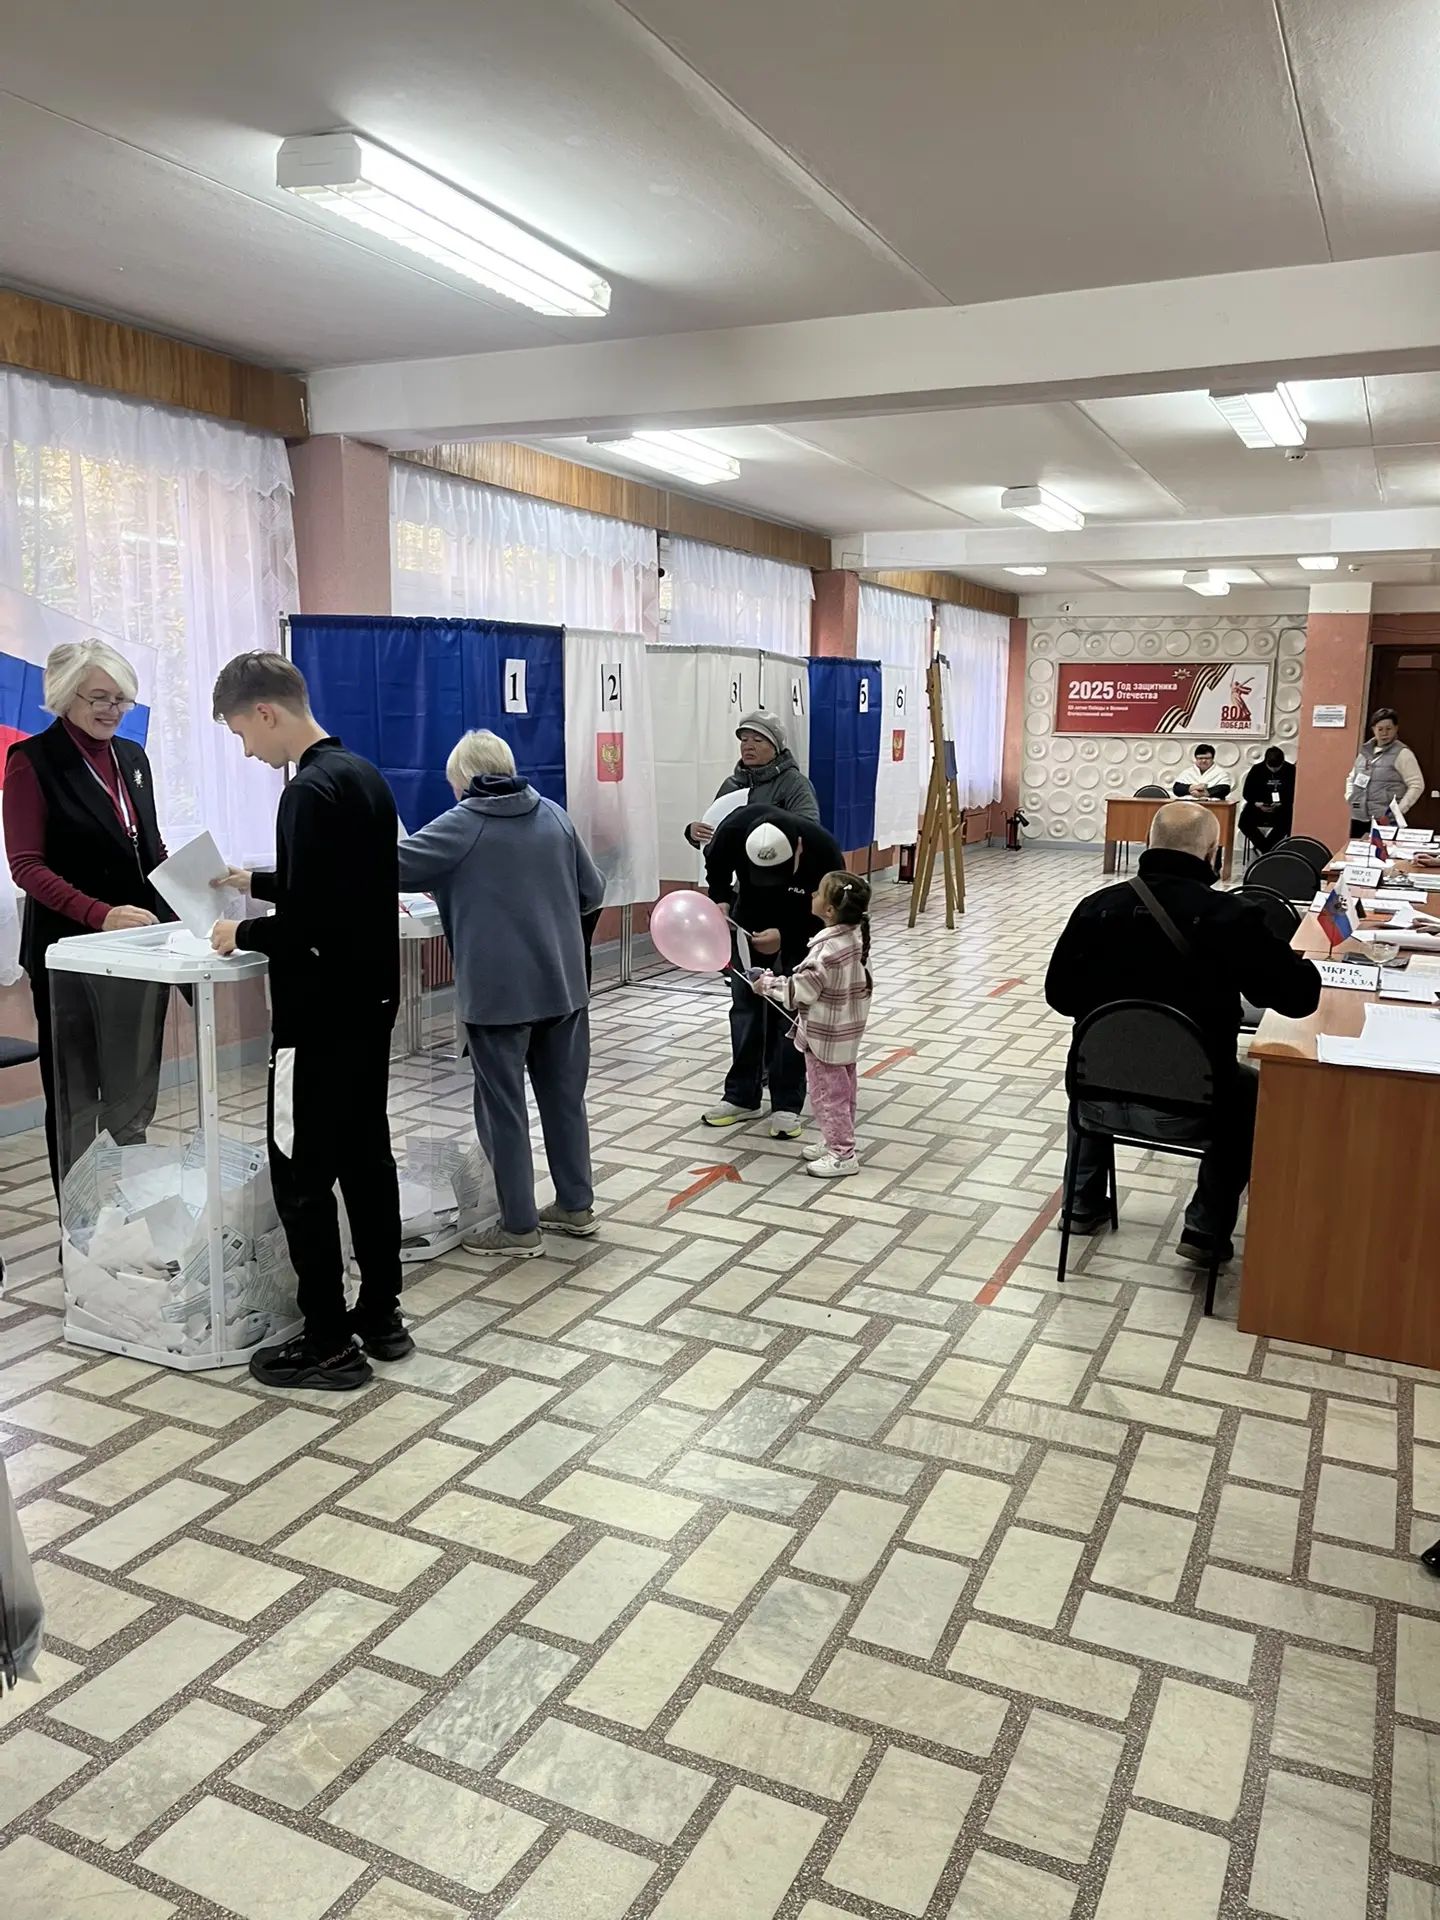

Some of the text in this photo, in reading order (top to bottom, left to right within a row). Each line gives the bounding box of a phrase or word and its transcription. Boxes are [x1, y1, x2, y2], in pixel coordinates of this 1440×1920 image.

[510, 672, 519, 701] 1
[608, 674, 618, 701] 2
[731, 682, 737, 703] 3
[793, 685, 798, 706] 4
[861, 684, 867, 704] 5
[1068, 681, 1114, 699] 2025
[1117, 682, 1177, 691] Год защитника
[1117, 691, 1158, 699] Отечества
[896, 689, 903, 708] 6
[1221, 706, 1238, 720] 80
[1321, 966, 1346, 975] МКР
